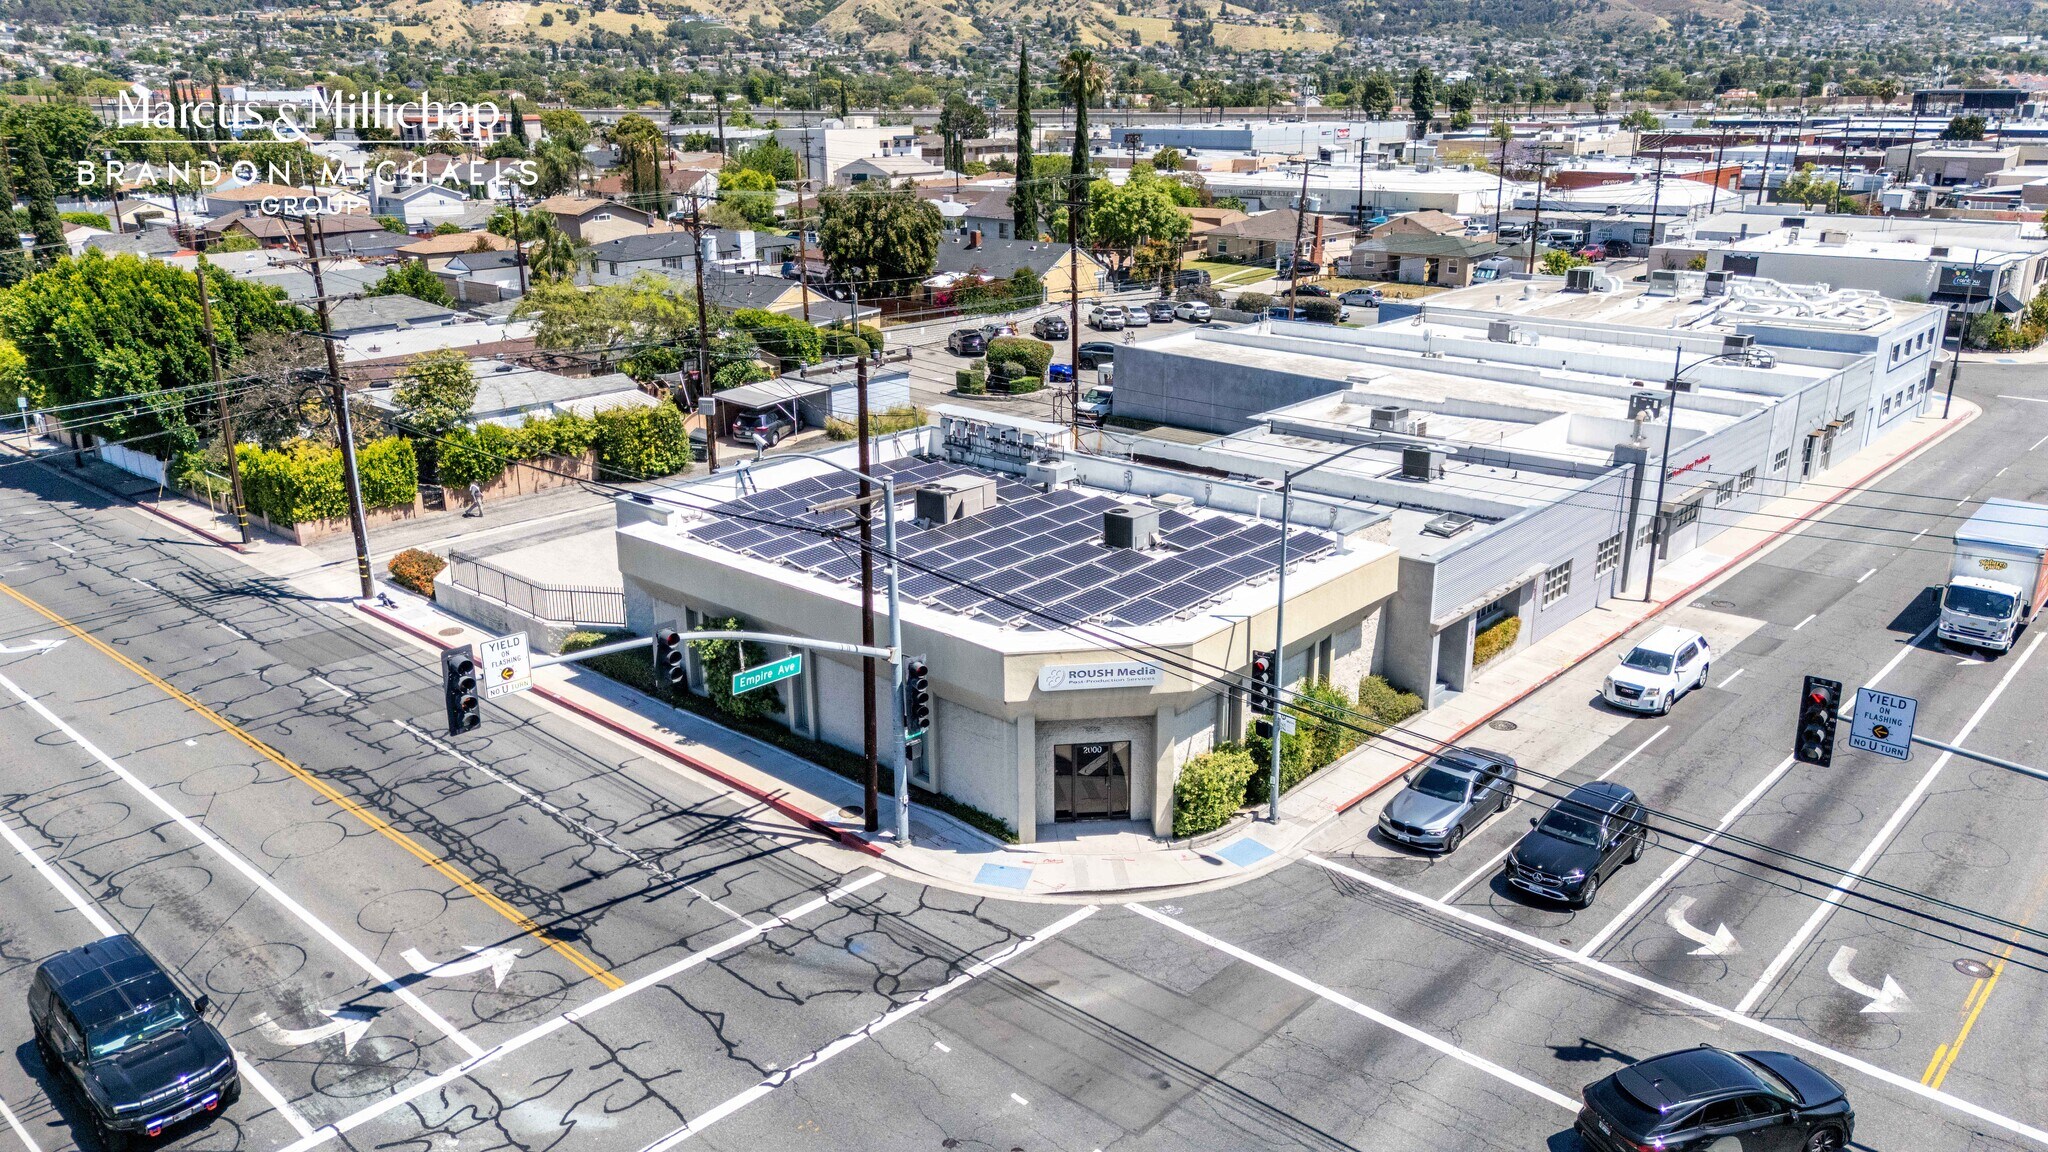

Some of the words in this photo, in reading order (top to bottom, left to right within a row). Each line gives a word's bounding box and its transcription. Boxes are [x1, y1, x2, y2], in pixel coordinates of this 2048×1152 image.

[489, 637, 520, 652] YIELD
[491, 655, 522, 668] FLASHING
[740, 670, 773, 688] Empire
[777, 663, 795, 676] Ave
[1069, 669, 1114, 679] ROUSH
[1117, 666, 1156, 677] Media
[490, 688, 500, 696] NO
[502, 685, 509, 693] U
[511, 681, 529, 690] TURN
[1868, 692, 1907, 709] YIELD
[1879, 707, 1890, 715] ON
[1864, 712, 1903, 727] FLASHING
[1083, 745, 1102, 754] 2000
[1853, 739, 1866, 747] NO
[1869, 741, 1877, 751] U
[1880, 745, 1904, 757] TURN
